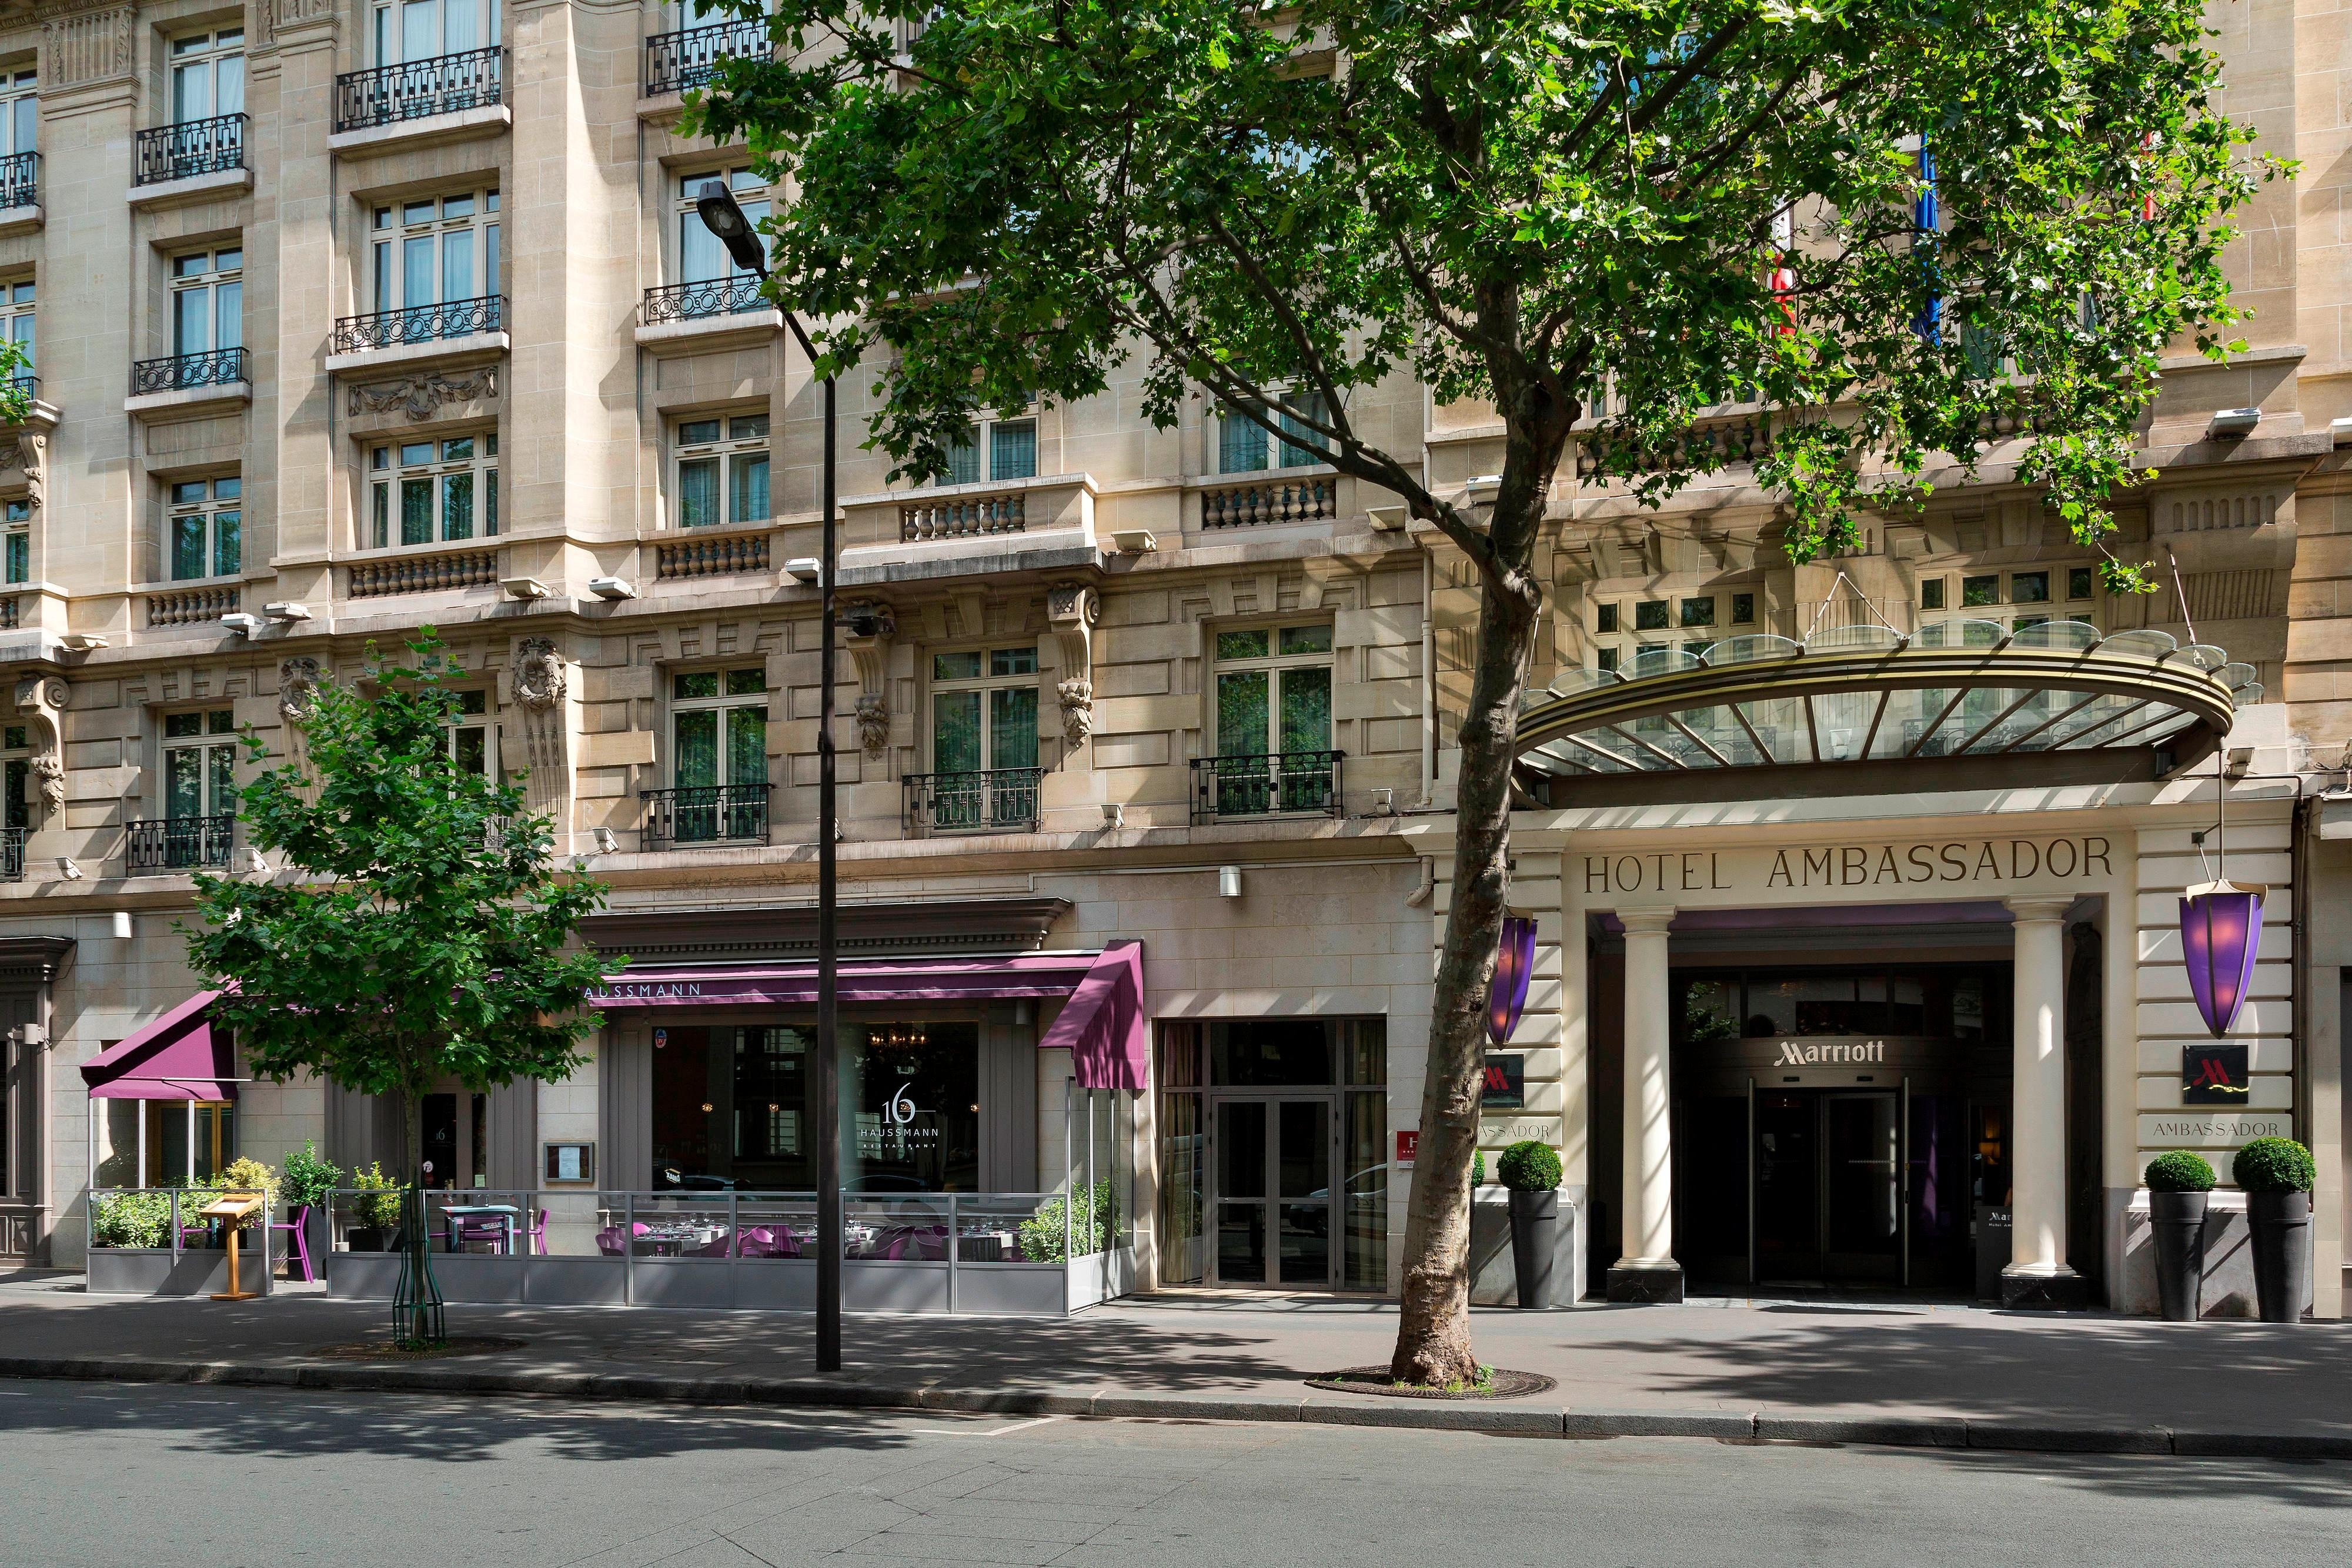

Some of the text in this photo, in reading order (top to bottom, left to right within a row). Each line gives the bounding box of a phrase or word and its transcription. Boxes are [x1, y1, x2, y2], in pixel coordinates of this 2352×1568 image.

[1584, 837, 2113, 893] HOTEL AMBASSADOR
[574, 984, 700, 998] AUSSMANN
[1773, 1041, 1885, 1066] Marriott
[882, 1082, 916, 1124] 16
[861, 1129, 938, 1137] HAUSSMANN
[1478, 1125, 1549, 1138] ASSADOR
[2153, 1123, 2278, 1136] AMBASSADOR
